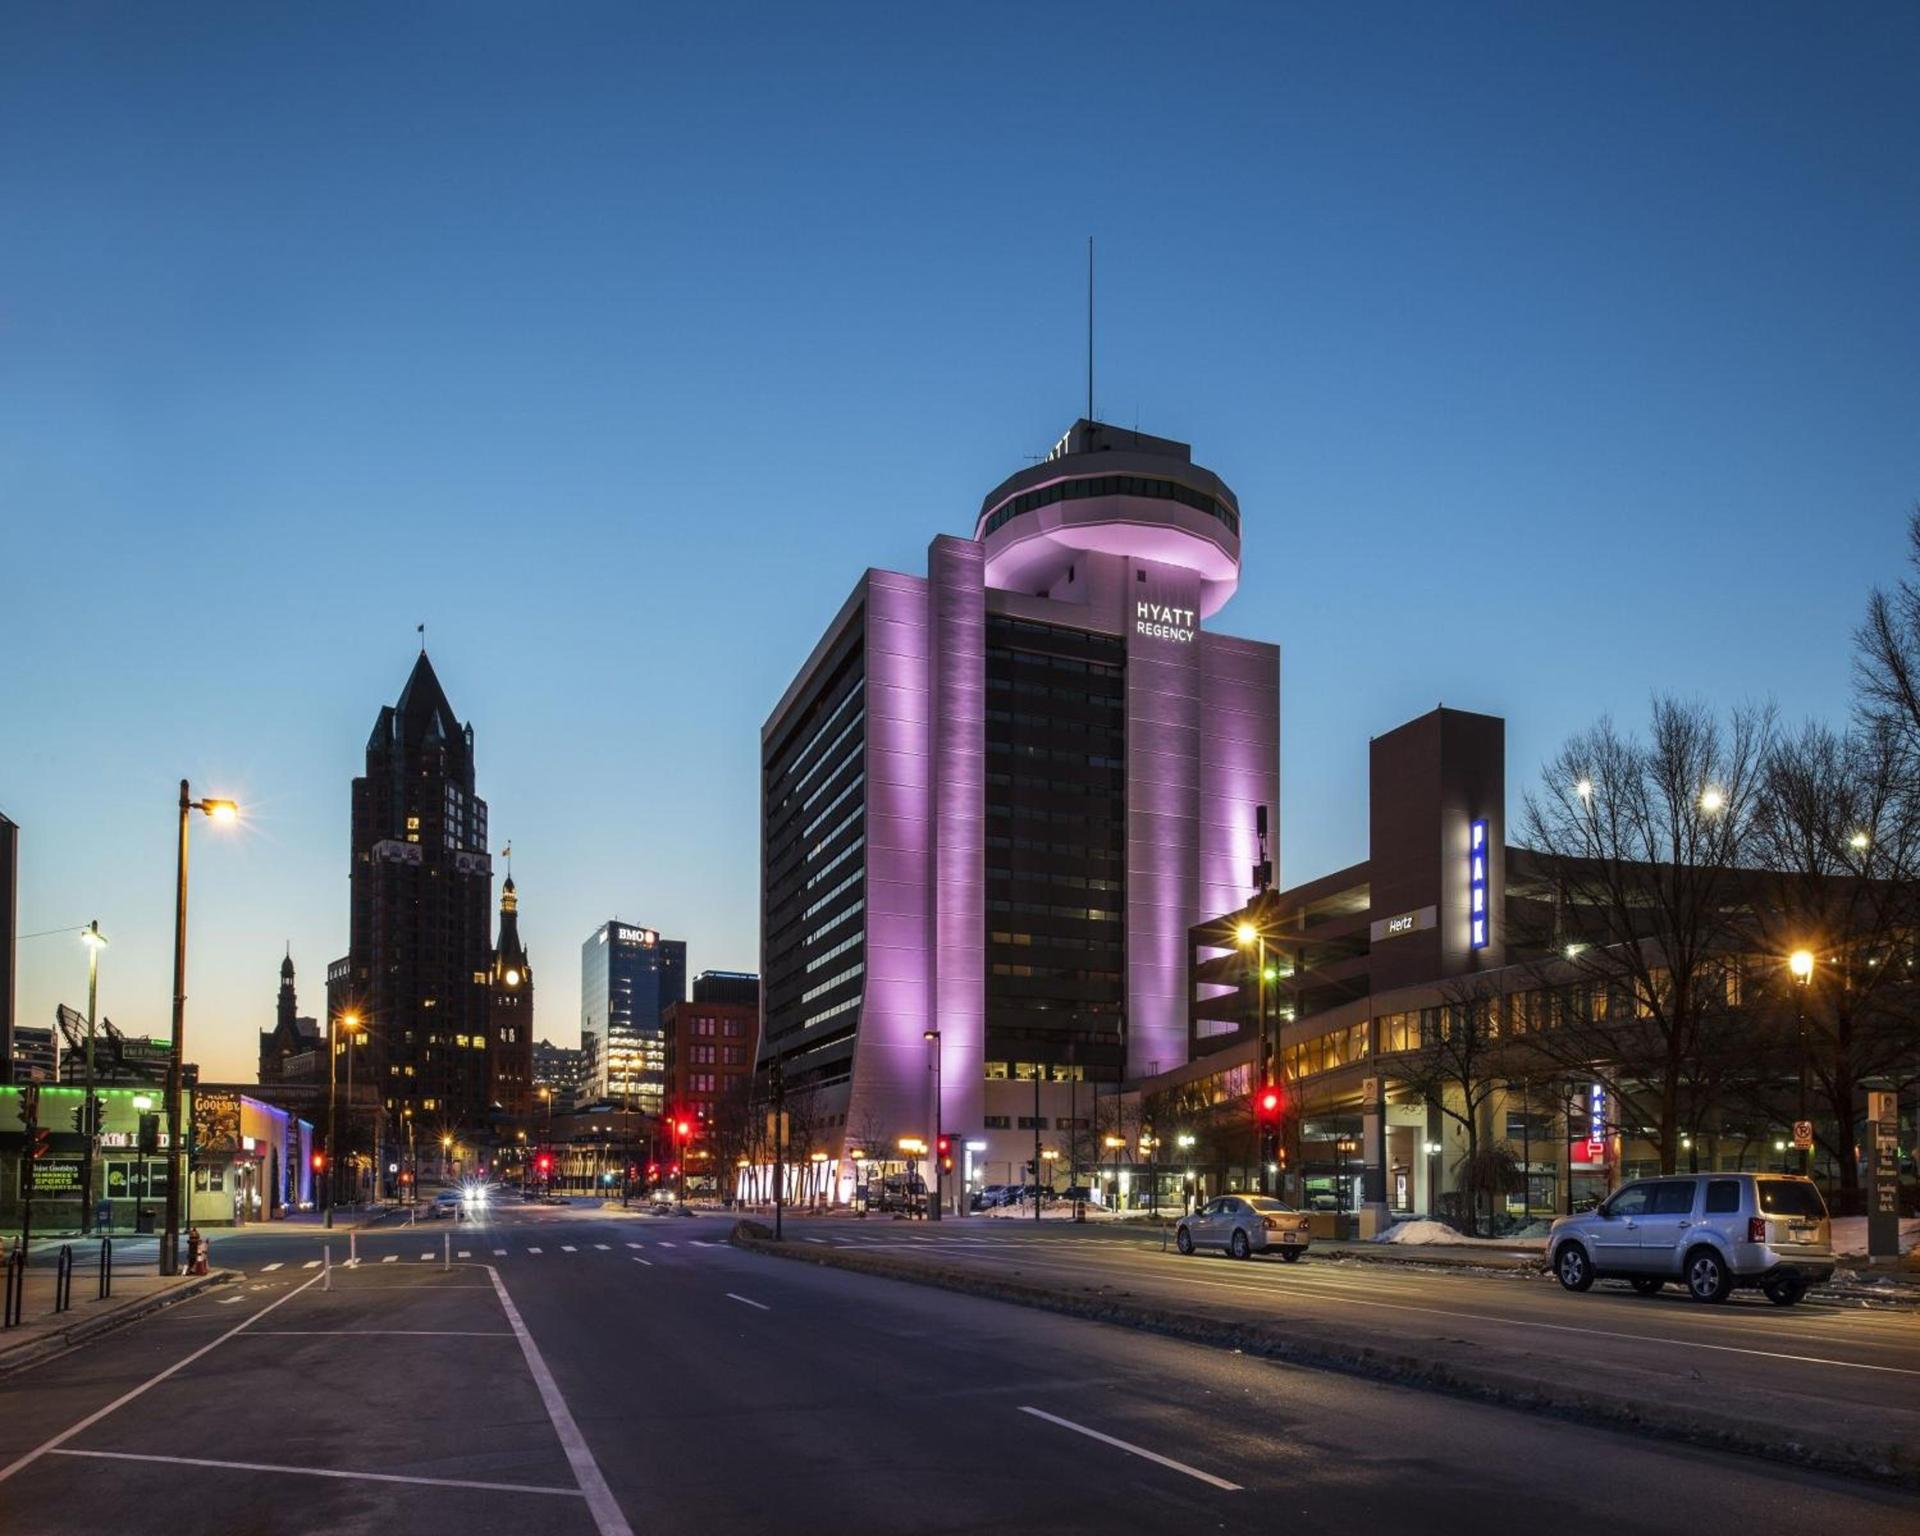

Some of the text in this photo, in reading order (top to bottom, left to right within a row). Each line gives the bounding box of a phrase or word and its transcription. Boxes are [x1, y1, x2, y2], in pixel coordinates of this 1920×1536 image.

[1045, 430, 1070, 462] ATT
[1137, 601, 1194, 627] HYATT
[1137, 620, 1194, 642] REGENCY
[1473, 825, 1483, 944] PARK
[619, 928, 644, 941] BMO
[1390, 917, 1412, 932] Hertz
